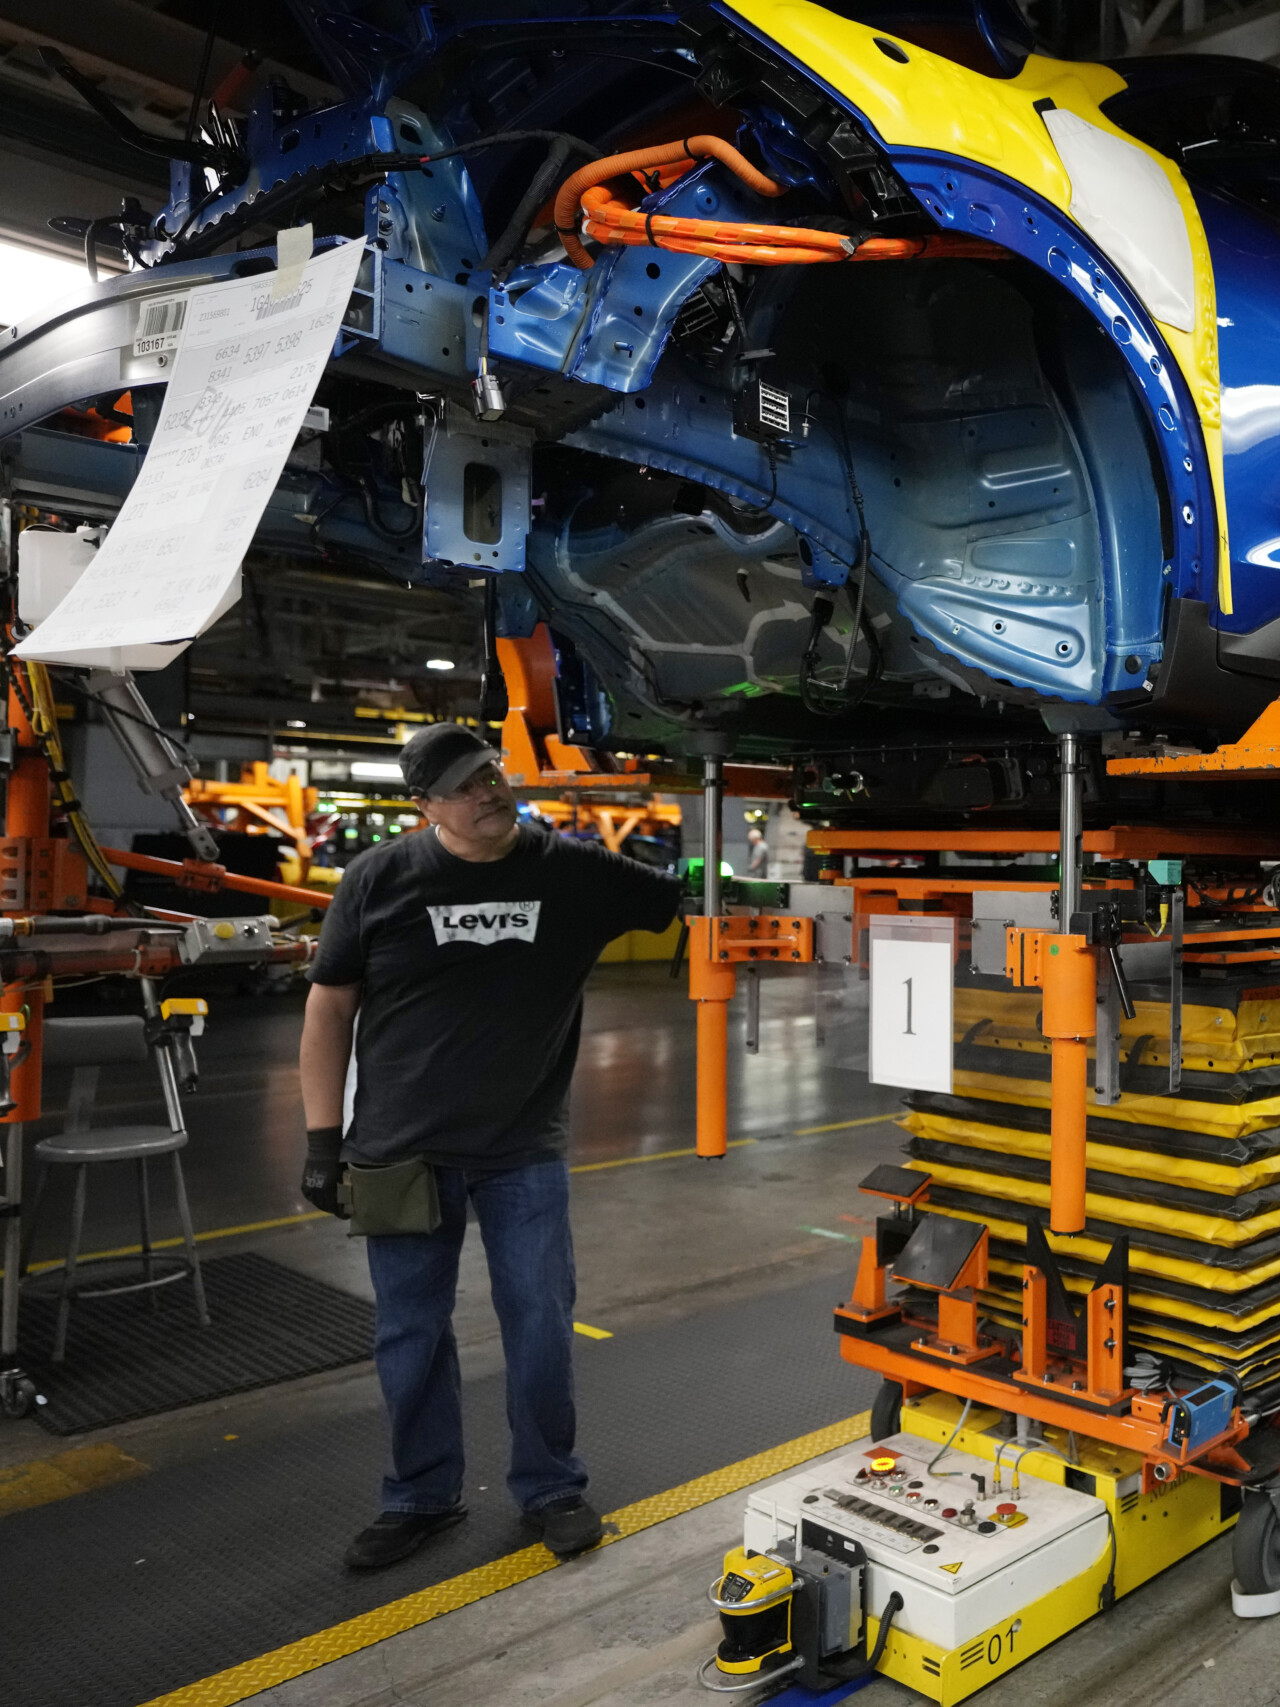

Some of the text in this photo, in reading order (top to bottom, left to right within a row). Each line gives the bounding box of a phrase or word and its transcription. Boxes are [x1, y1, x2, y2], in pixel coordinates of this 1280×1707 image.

[136, 338, 165, 354] 103167
[215, 330, 303, 364] 6634 5397 5398
[208, 366, 233, 383] 8341
[442, 912, 529, 930] Levi's
[901, 976, 917, 1036] 1
